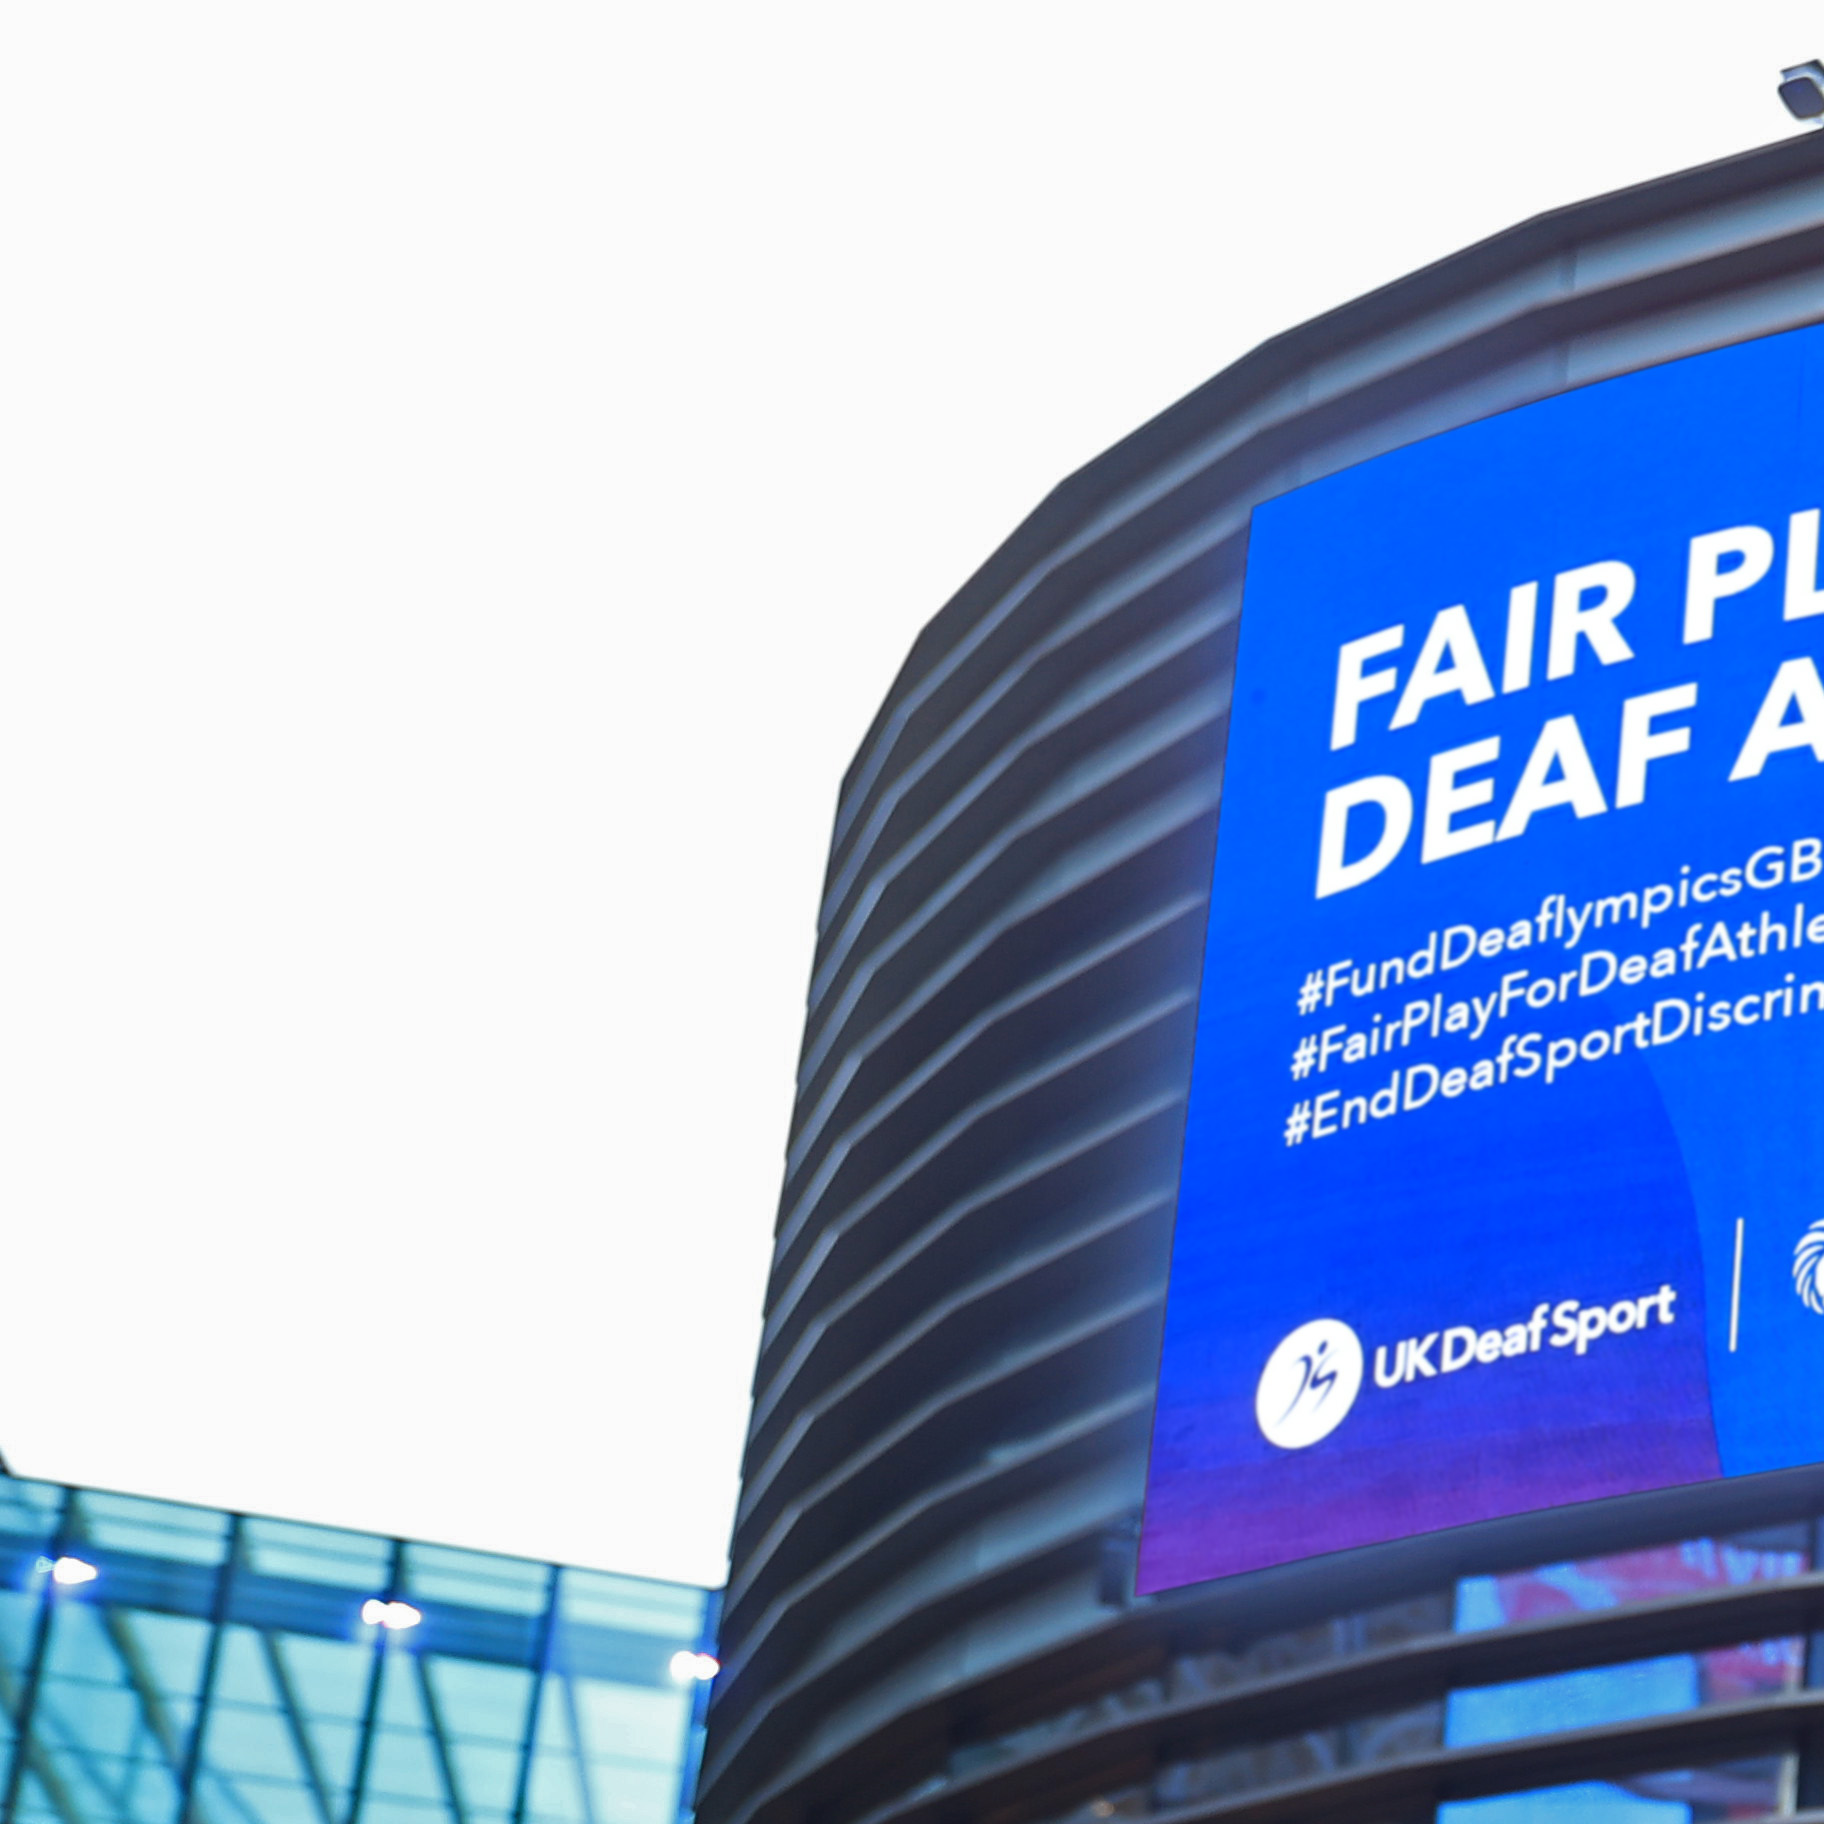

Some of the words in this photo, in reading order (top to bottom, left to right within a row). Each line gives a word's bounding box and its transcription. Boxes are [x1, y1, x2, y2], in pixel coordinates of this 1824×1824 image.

[1329, 560, 1637, 752] FAIR
[1314, 682, 1699, 900] DEAF
[1296, 837, 1824, 1017] #FundDeaflympicsGB
